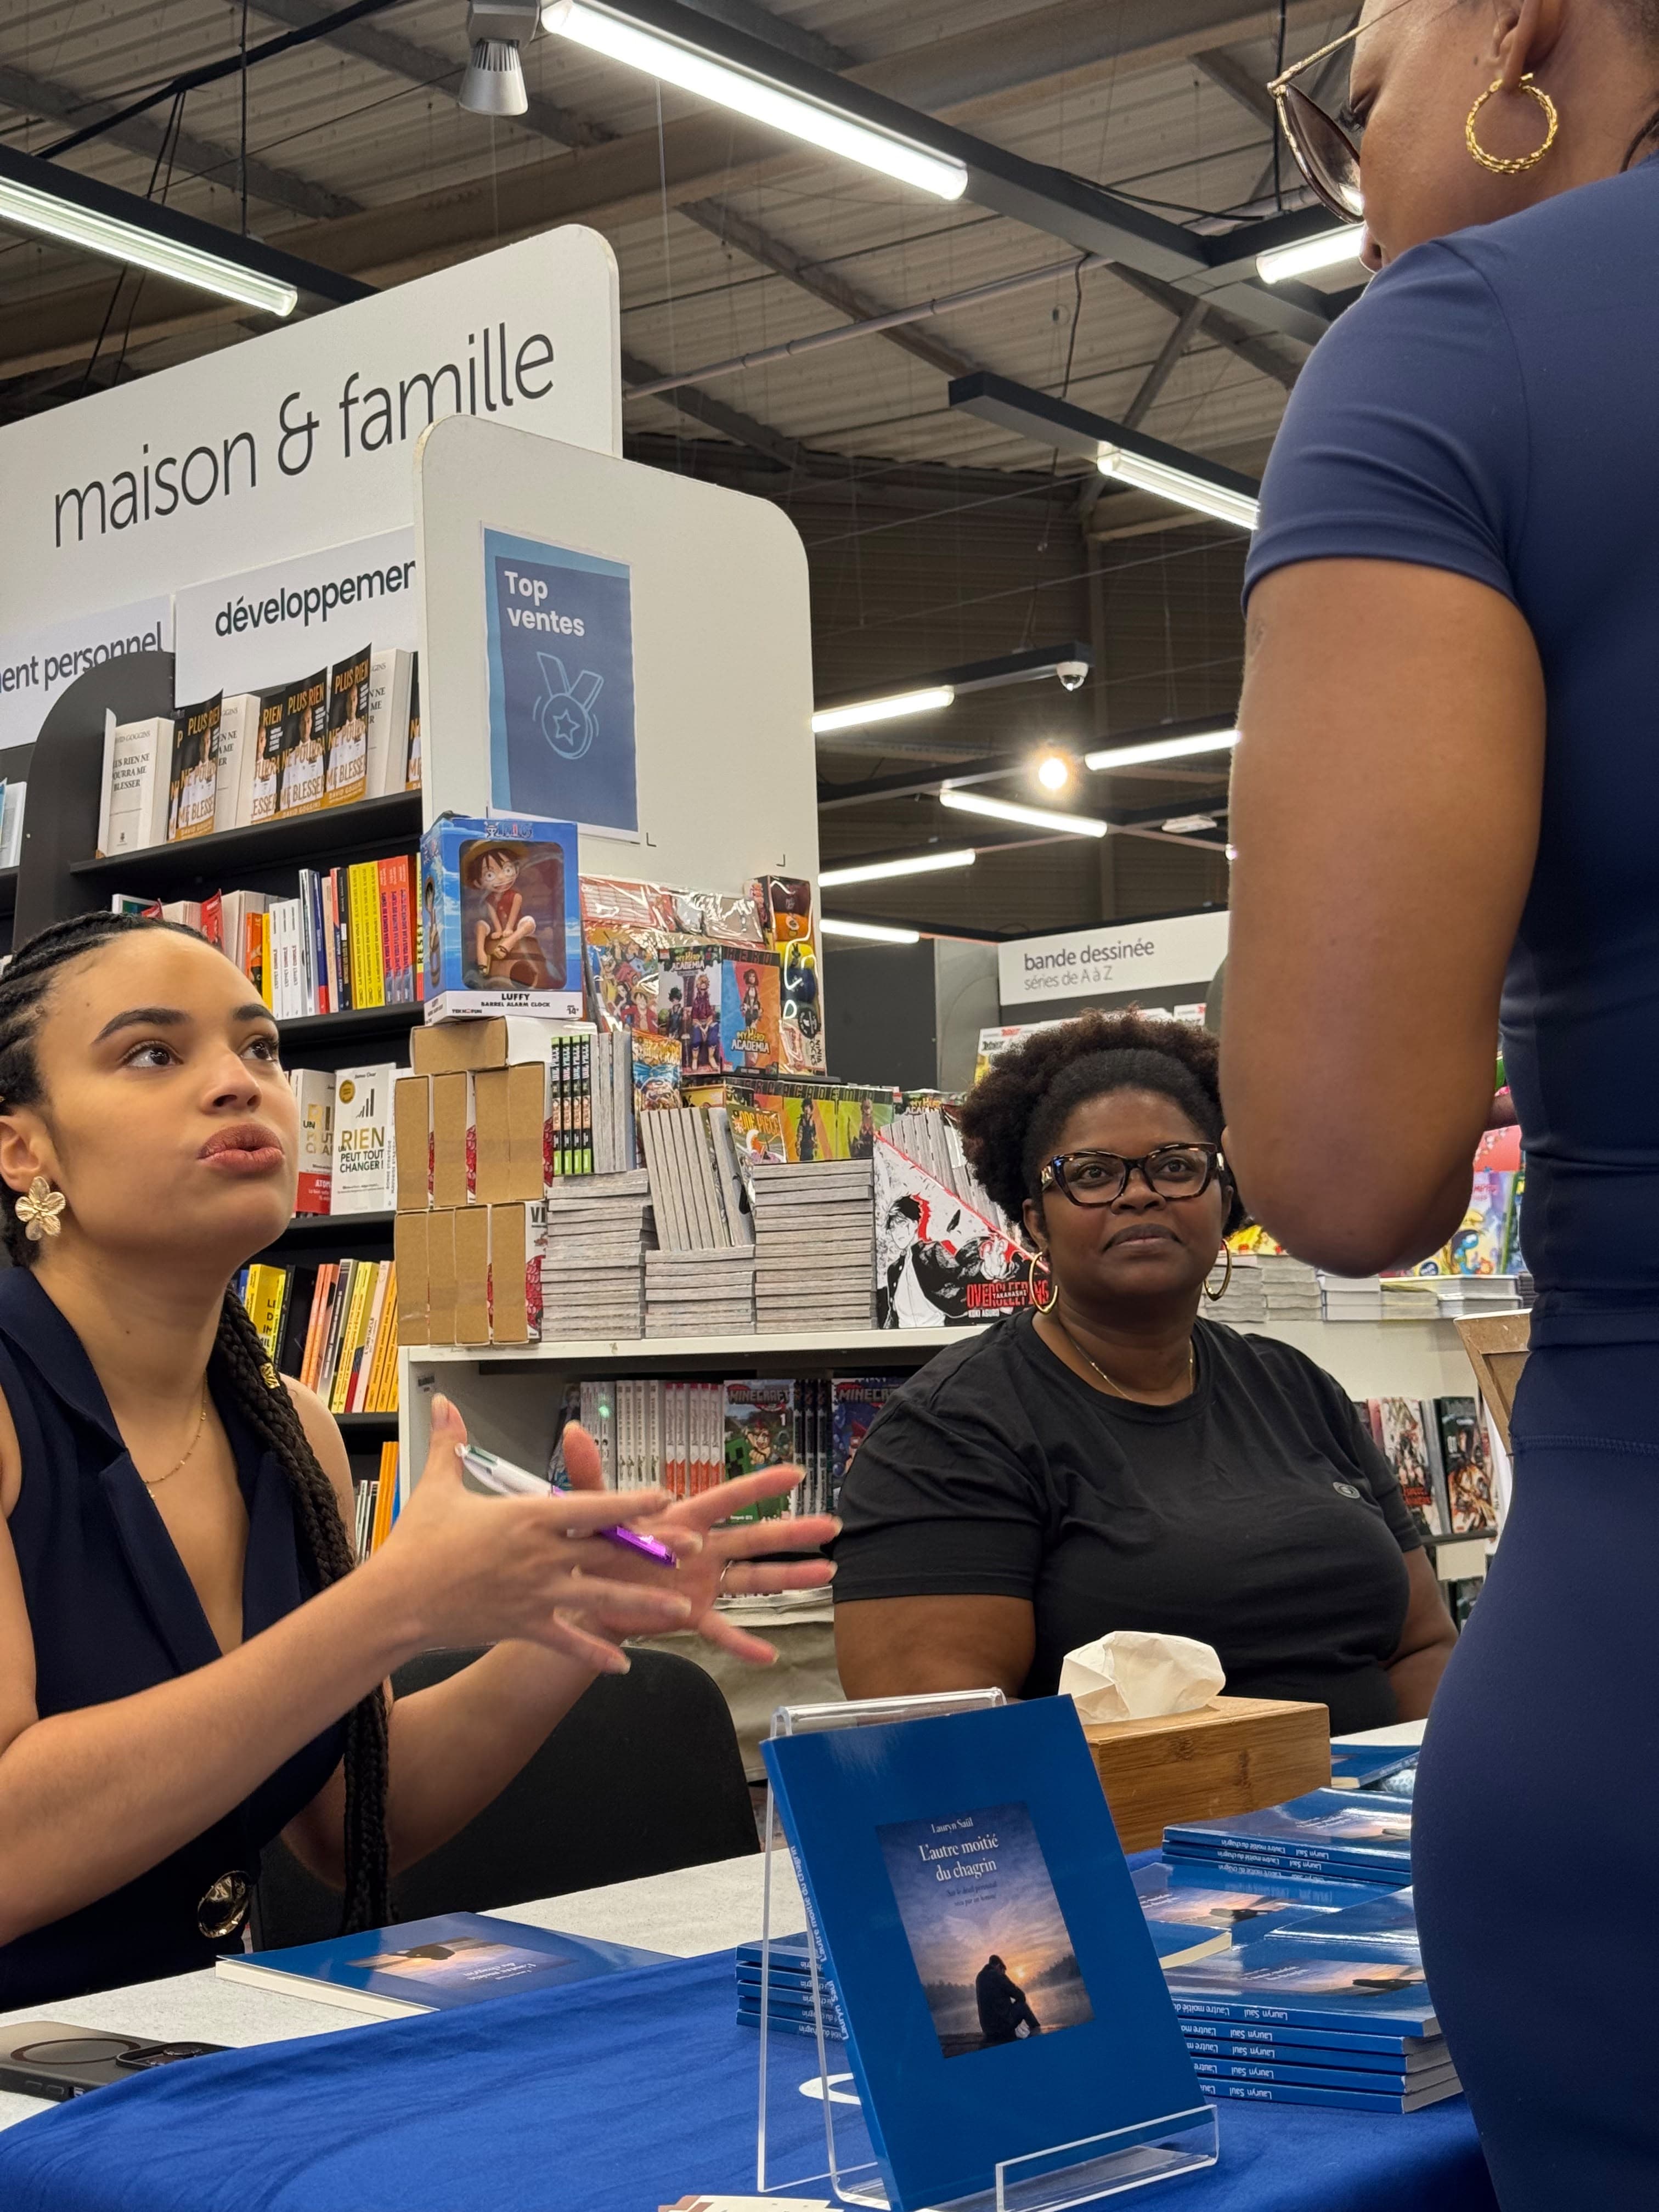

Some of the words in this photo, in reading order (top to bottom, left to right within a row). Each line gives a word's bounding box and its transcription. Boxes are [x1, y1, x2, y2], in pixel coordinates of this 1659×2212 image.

[55, 432, 257, 548] maison
[277, 392, 320, 476] &
[338, 321, 554, 458] famille
[504, 571, 548, 606] Top
[506, 607, 585, 637] ventes
[0, 656, 39, 693] ent
[44, 621, 163, 692] personnel
[335, 670, 353, 694] PLUS
[354, 658, 369, 681] RIEN
[287, 689, 307, 716] PLUS
[308, 682, 324, 706] RIEN
[263, 704, 283, 726] RIEN
[188, 714, 207, 736] PLUS
[123, 754, 139, 766] RIEN
[113, 768, 136, 780] OURRA
[113, 779, 140, 792] BLESSER
[1024, 948, 1077, 971] bande
[1080, 938, 1154, 964] dessinée
[671, 961, 705, 971] ACADEMIA
[1024, 972, 1059, 991] séries
[1062, 969, 1079, 986] de
[1081, 969, 1091, 984] A
[1093, 969, 1102, 981] à
[1103, 966, 1113, 981] Z
[731, 1039, 770, 1054] ACADEMIA
[341, 1126, 385, 1151] RIEN
[341, 1151, 360, 1163] PEUT
[364, 1149, 384, 1160] TOUT
[340, 1160, 380, 1173] CHANGER
[992, 1290, 1028, 1300] TAKAHASHI
[728, 1385, 790, 1403] MINECRAFT
[838, 1386, 893, 1403] MINECR
[780, 1413, 786, 1426] 1
[931, 1822, 957, 1833] Lauryn
[918, 1844, 959, 1861] L'autre
[961, 1833, 999, 1854] moitié
[791, 1846, 804, 1882] chagrin
[936, 1864, 951, 1882] du
[953, 1858, 997, 1879] chagrin
[801, 1883, 808, 1895] du
[814, 1928, 827, 1962] L'autre
[826, 1980, 838, 2002] Saul
[1183, 2005, 1204, 2013] moitié
[1206, 2006, 1229, 2016] L'autre
[1244, 2009, 1260, 2018] Saul
[1263, 2010, 1288, 2020] Lauryn
[835, 2005, 849, 2041] Lauryn
[1193, 2026, 1216, 2036] L'autre
[1231, 2029, 1245, 2039] Saul
[1248, 2030, 1272, 2041] Lauryn
[1195, 2044, 1218, 2053] L'autre
[1233, 2047, 1247, 2056] Saul
[1250, 2047, 1275, 2058] Lauryn
[1194, 2063, 1217, 2073] L'autre
[1232, 2067, 1246, 2076] Saul
[1249, 2068, 1274, 2079] Lauryn
[1229, 2087, 1244, 2096] Saul
[1247, 2089, 1272, 2100] Lauryn
